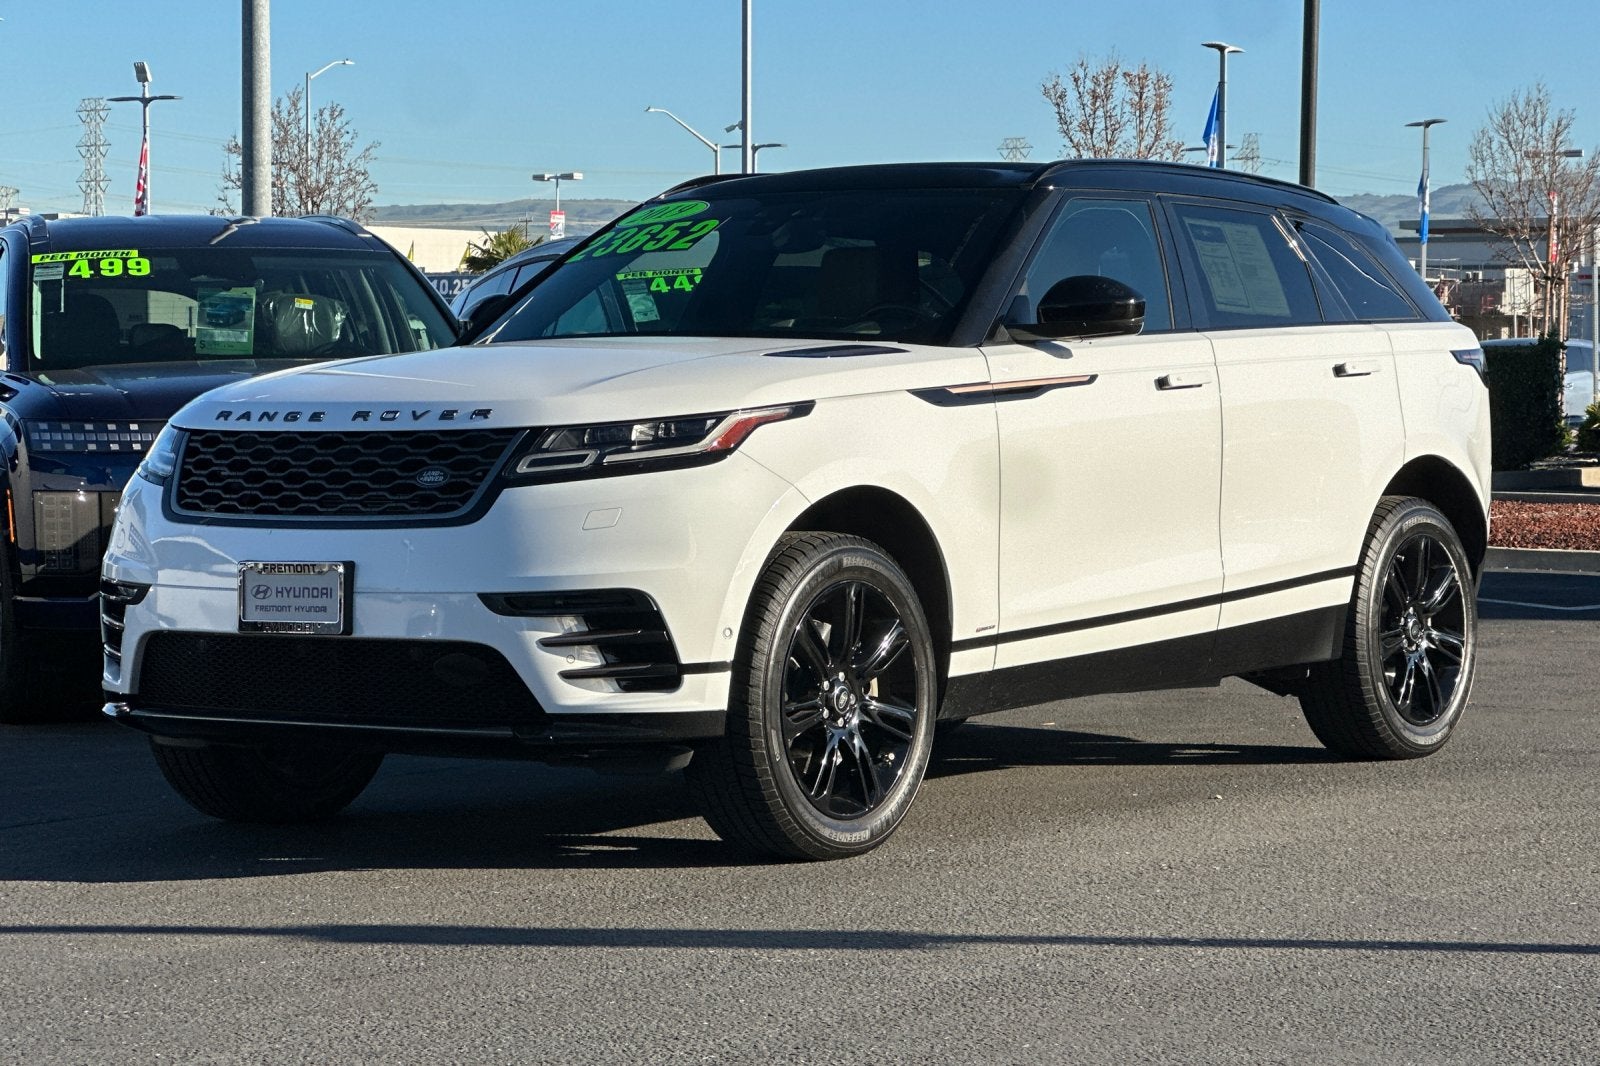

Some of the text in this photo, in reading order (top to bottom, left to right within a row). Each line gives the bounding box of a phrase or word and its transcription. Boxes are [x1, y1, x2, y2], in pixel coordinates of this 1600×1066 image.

[40, 250, 131, 262] PER MONTH
[68, 257, 151, 278] 499
[624, 268, 694, 279] PER MONTH
[215, 409, 494, 422] RANGE ROVER
[261, 563, 317, 574] FREMONT
[275, 587, 333, 599] HYUNDAI
[254, 604, 328, 614] FREMONT HYUNDAI
